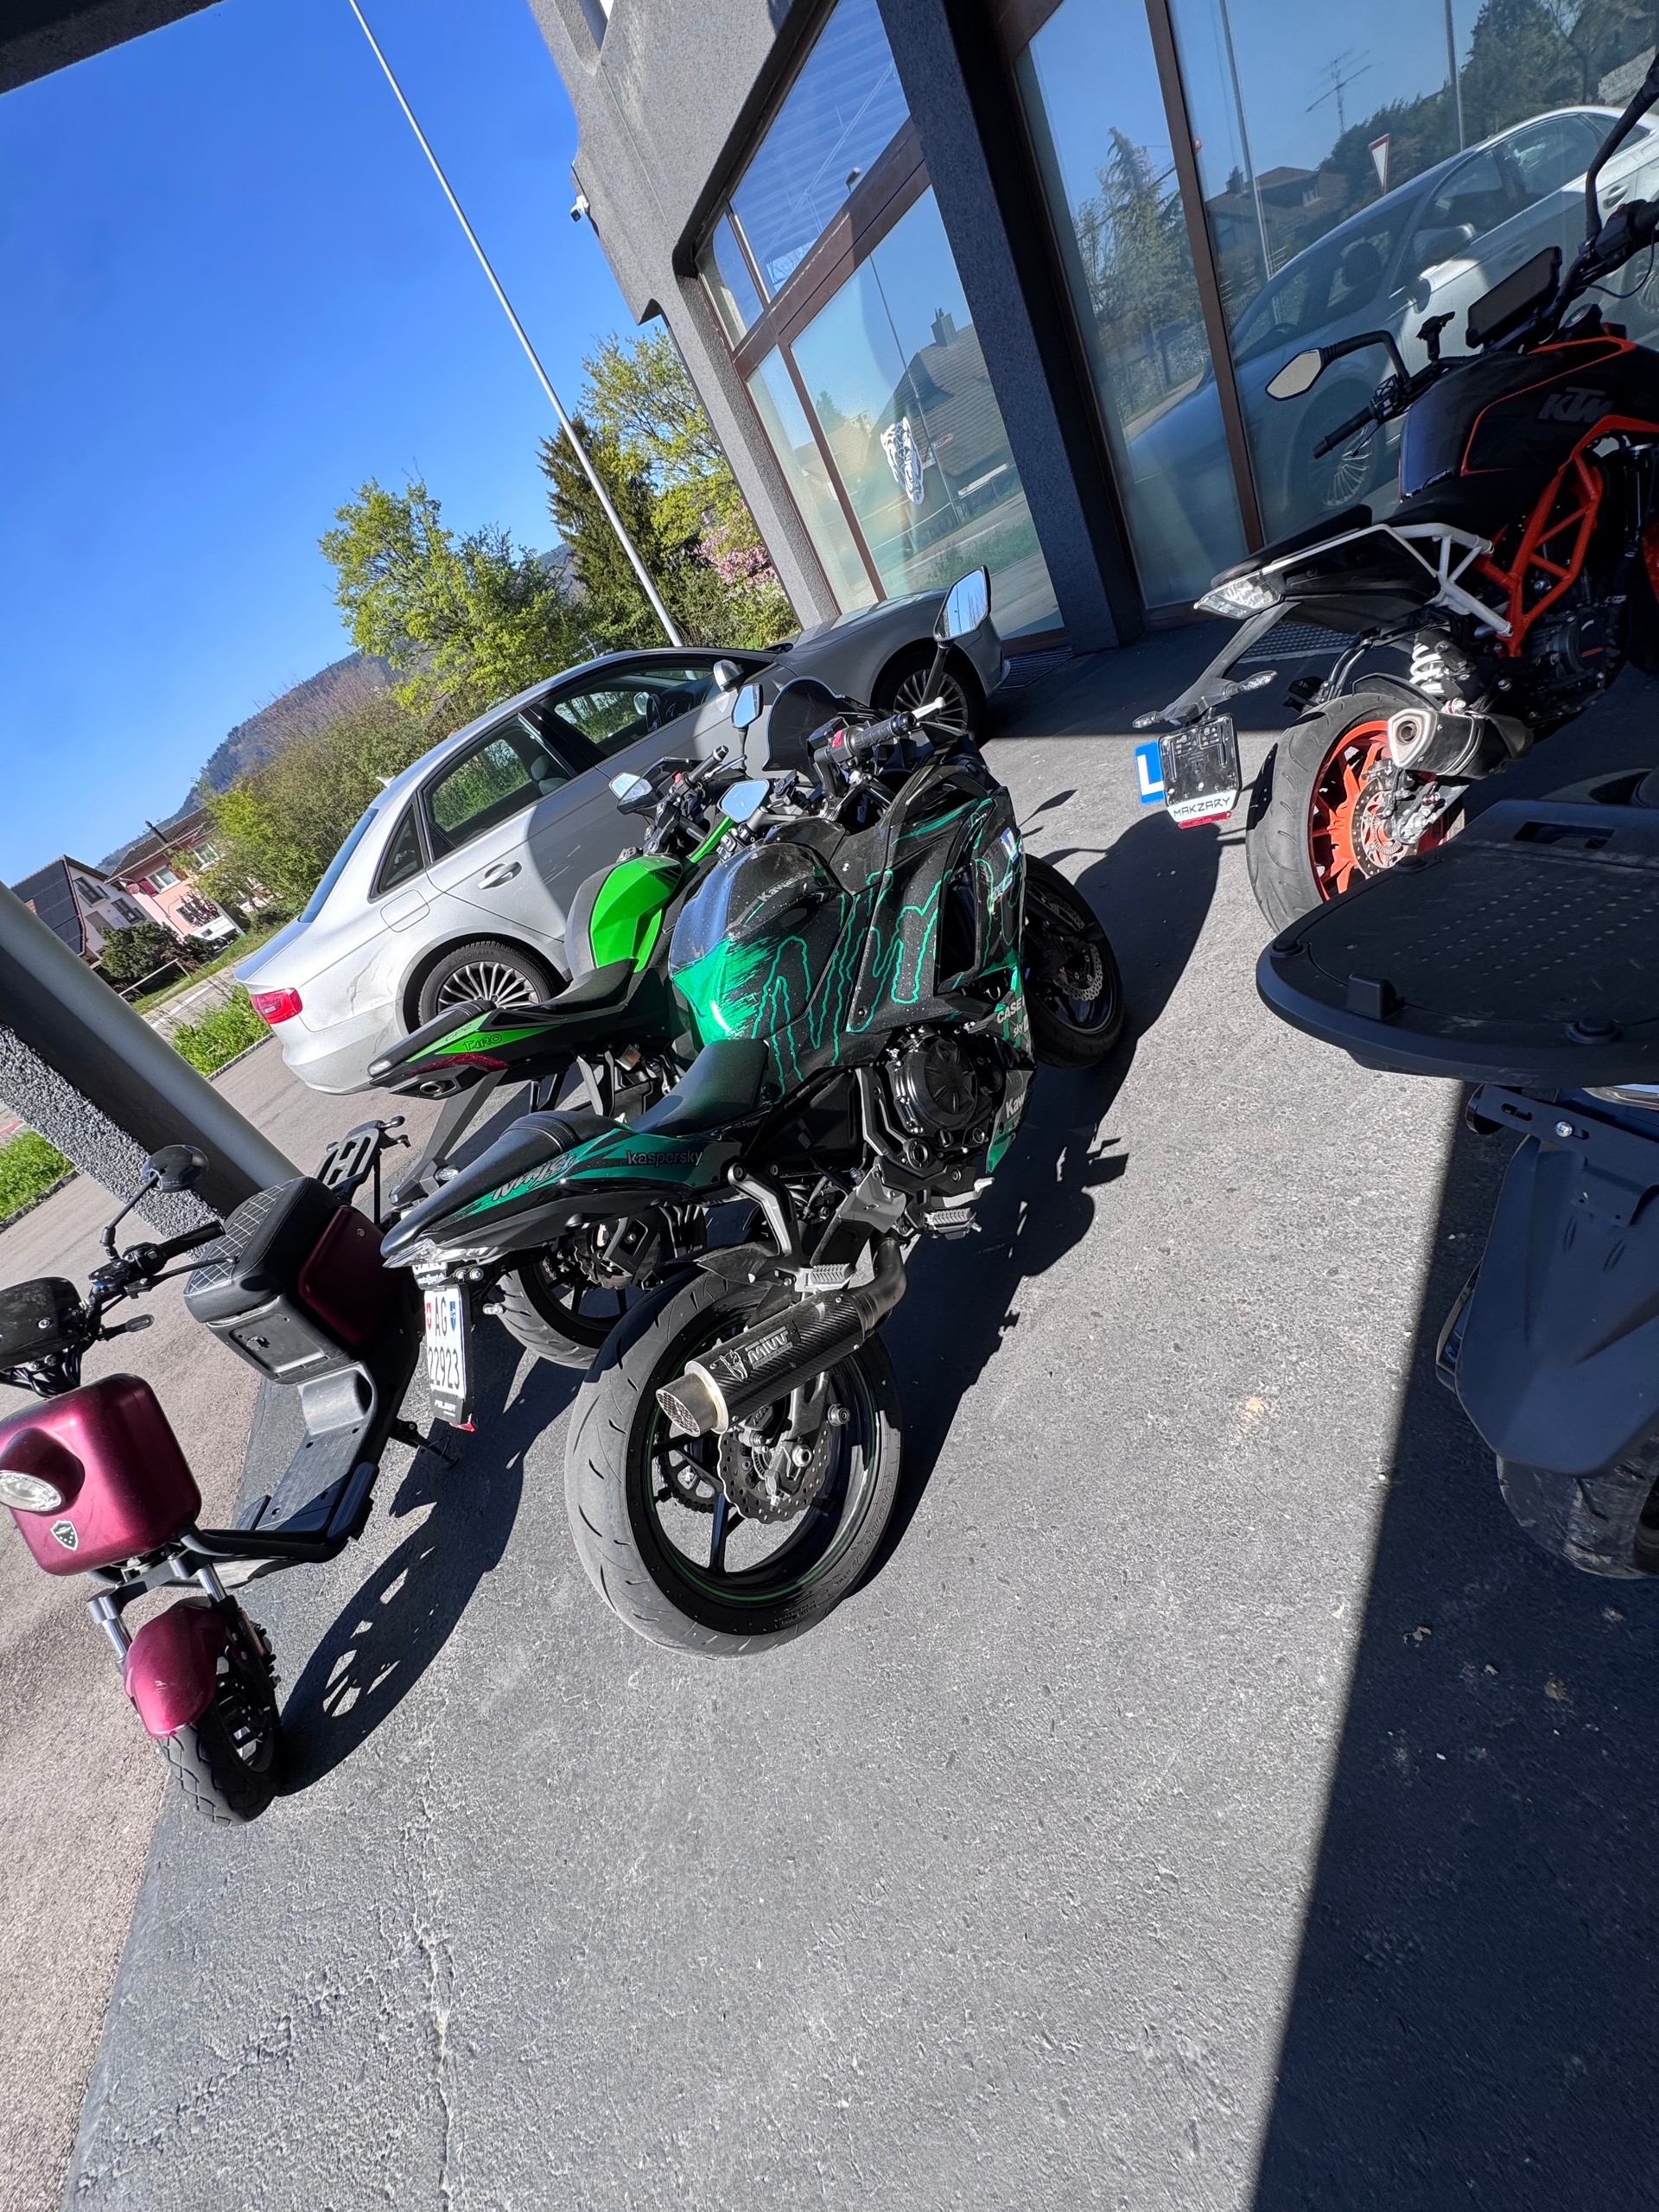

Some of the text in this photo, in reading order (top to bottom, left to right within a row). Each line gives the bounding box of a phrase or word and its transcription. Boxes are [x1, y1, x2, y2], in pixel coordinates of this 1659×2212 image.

[1537, 387, 1613, 423] KTM
[1137, 754, 1165, 796] L
[1173, 797, 1230, 817] MAKZARY
[454, 950, 495, 963] YOKOHAMA
[626, 1150, 703, 1167] kaspersky
[435, 1296, 448, 1337] AG
[428, 1346, 460, 1390] 22923
